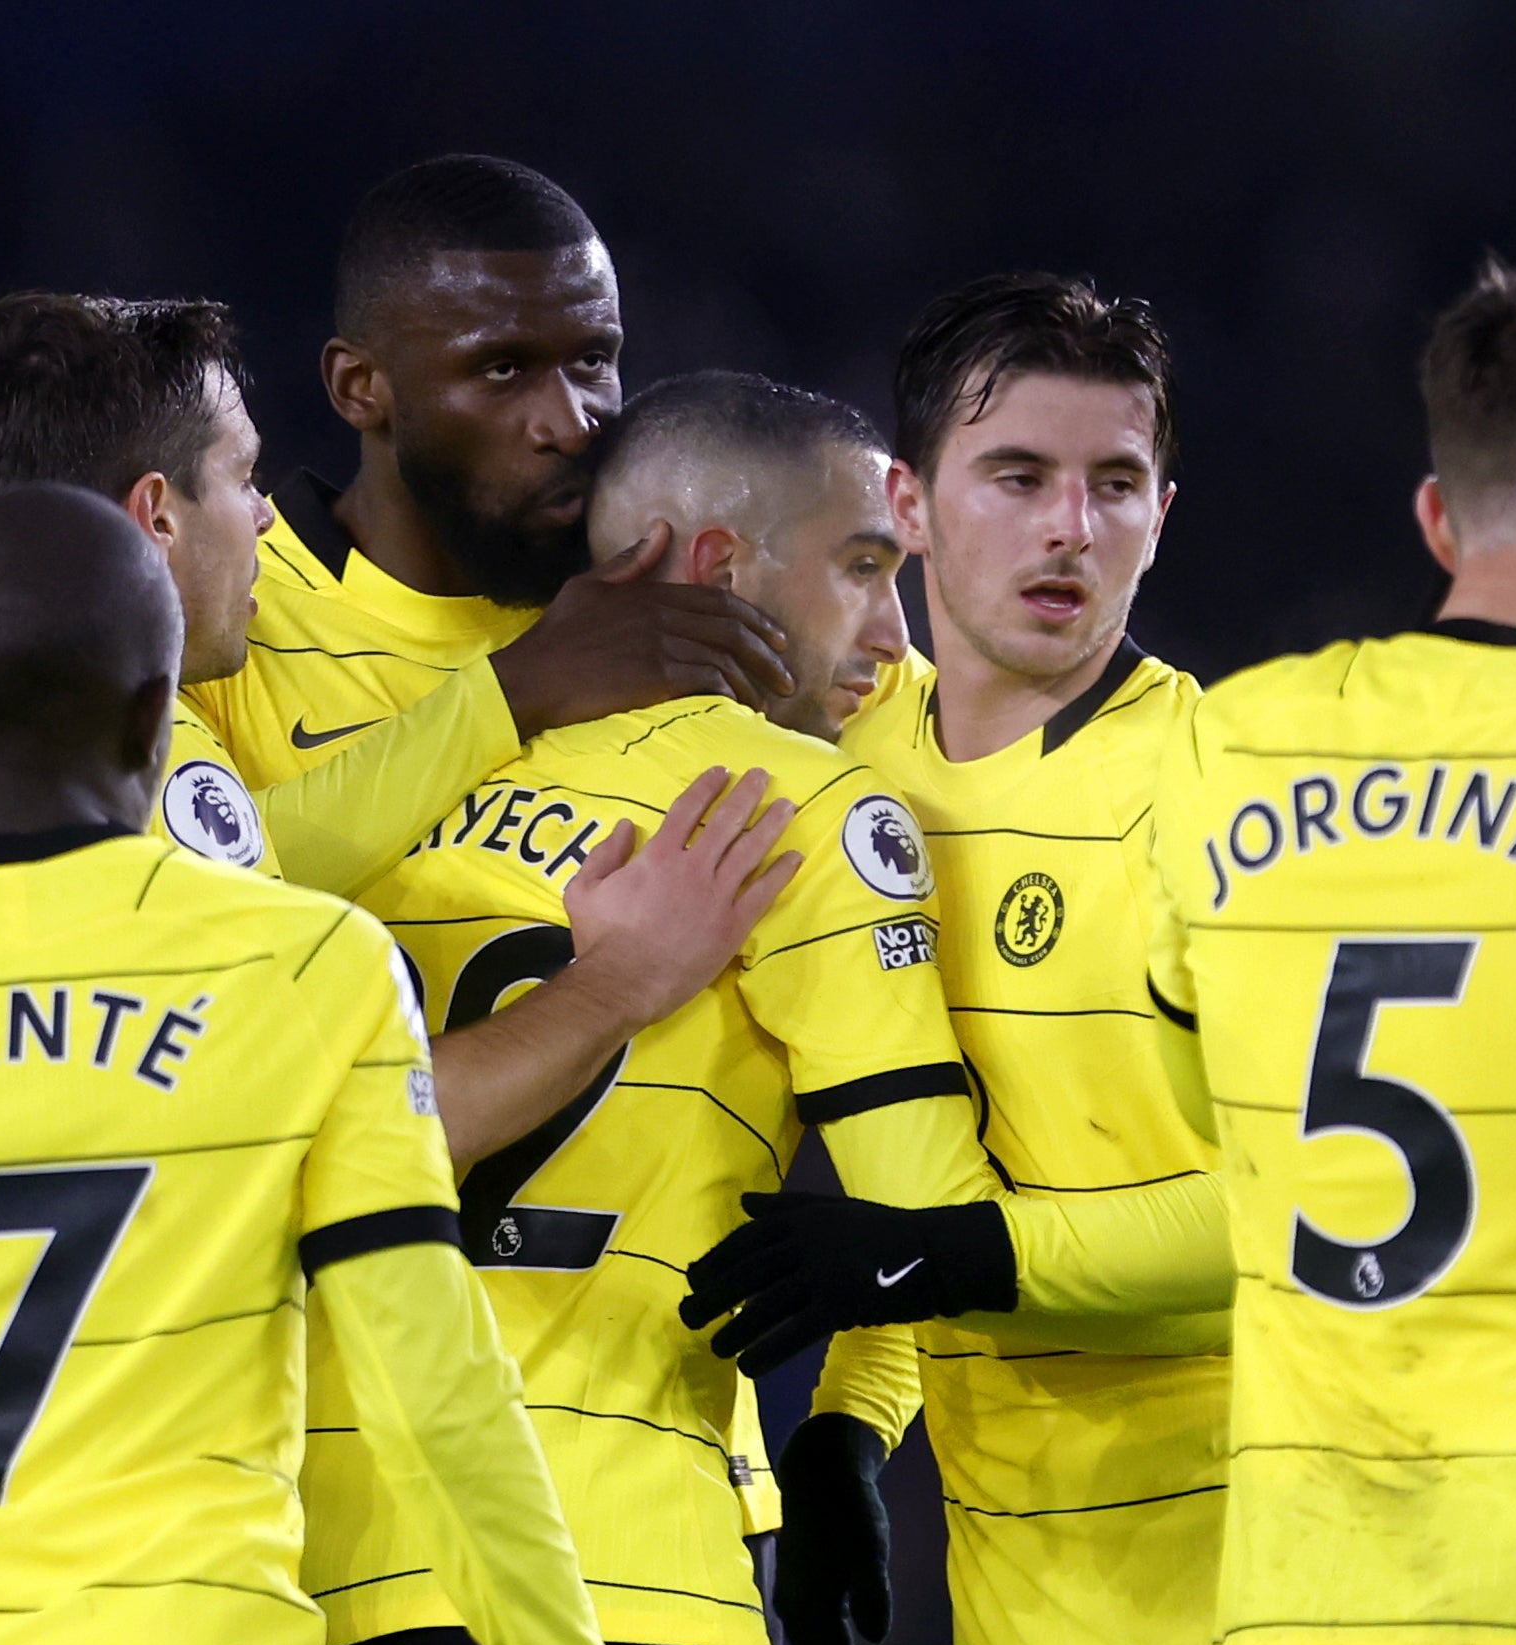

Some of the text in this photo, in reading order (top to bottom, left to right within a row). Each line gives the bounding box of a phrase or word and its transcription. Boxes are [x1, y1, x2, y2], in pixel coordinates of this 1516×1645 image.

[873, 923, 912, 949] No
[1012, 873, 1059, 898] CHELSEA
[396, 922, 633, 1273] 2
[1290, 936, 1483, 1313] 5
